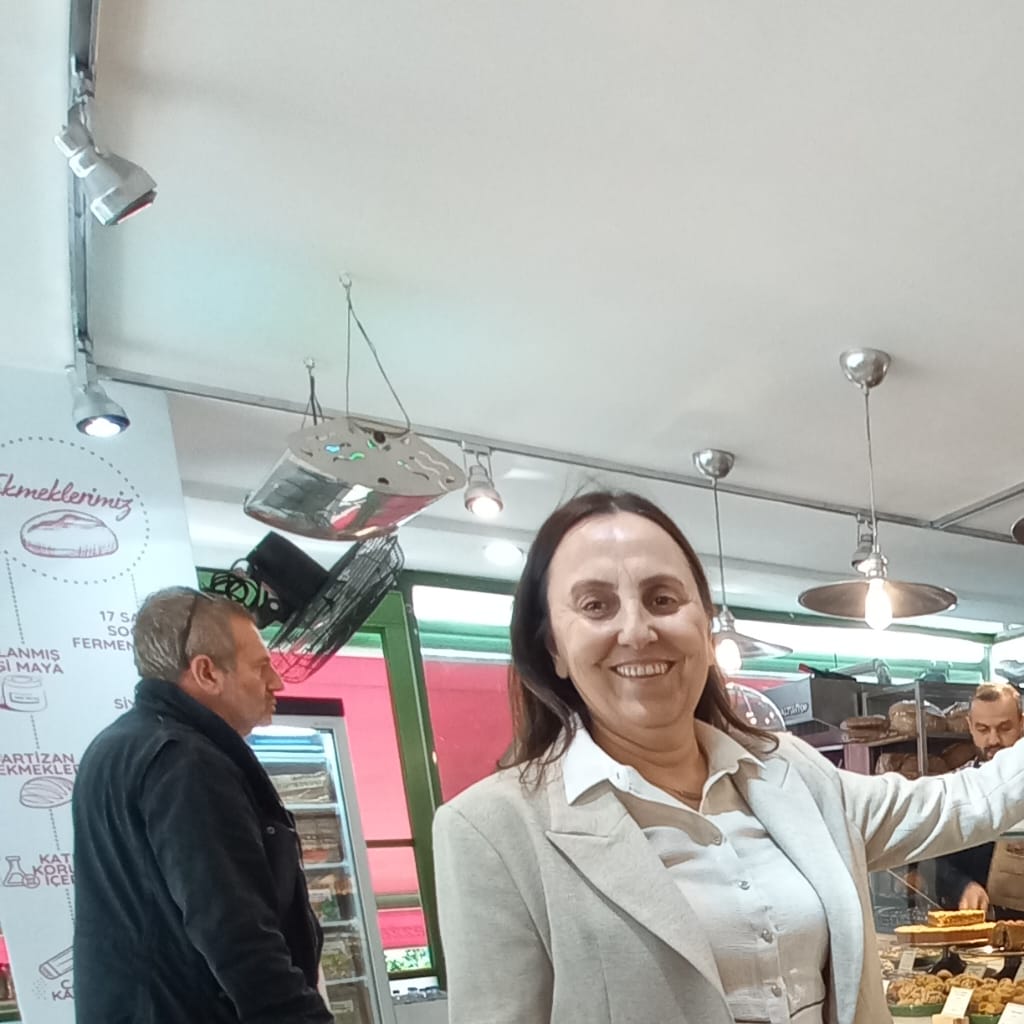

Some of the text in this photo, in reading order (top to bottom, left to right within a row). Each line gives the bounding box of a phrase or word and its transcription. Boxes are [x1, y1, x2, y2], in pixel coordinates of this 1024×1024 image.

[99, 610, 115, 622] 17
[16, 660, 65, 674] MAYA
[1, 751, 75, 764] ARTİZAN
